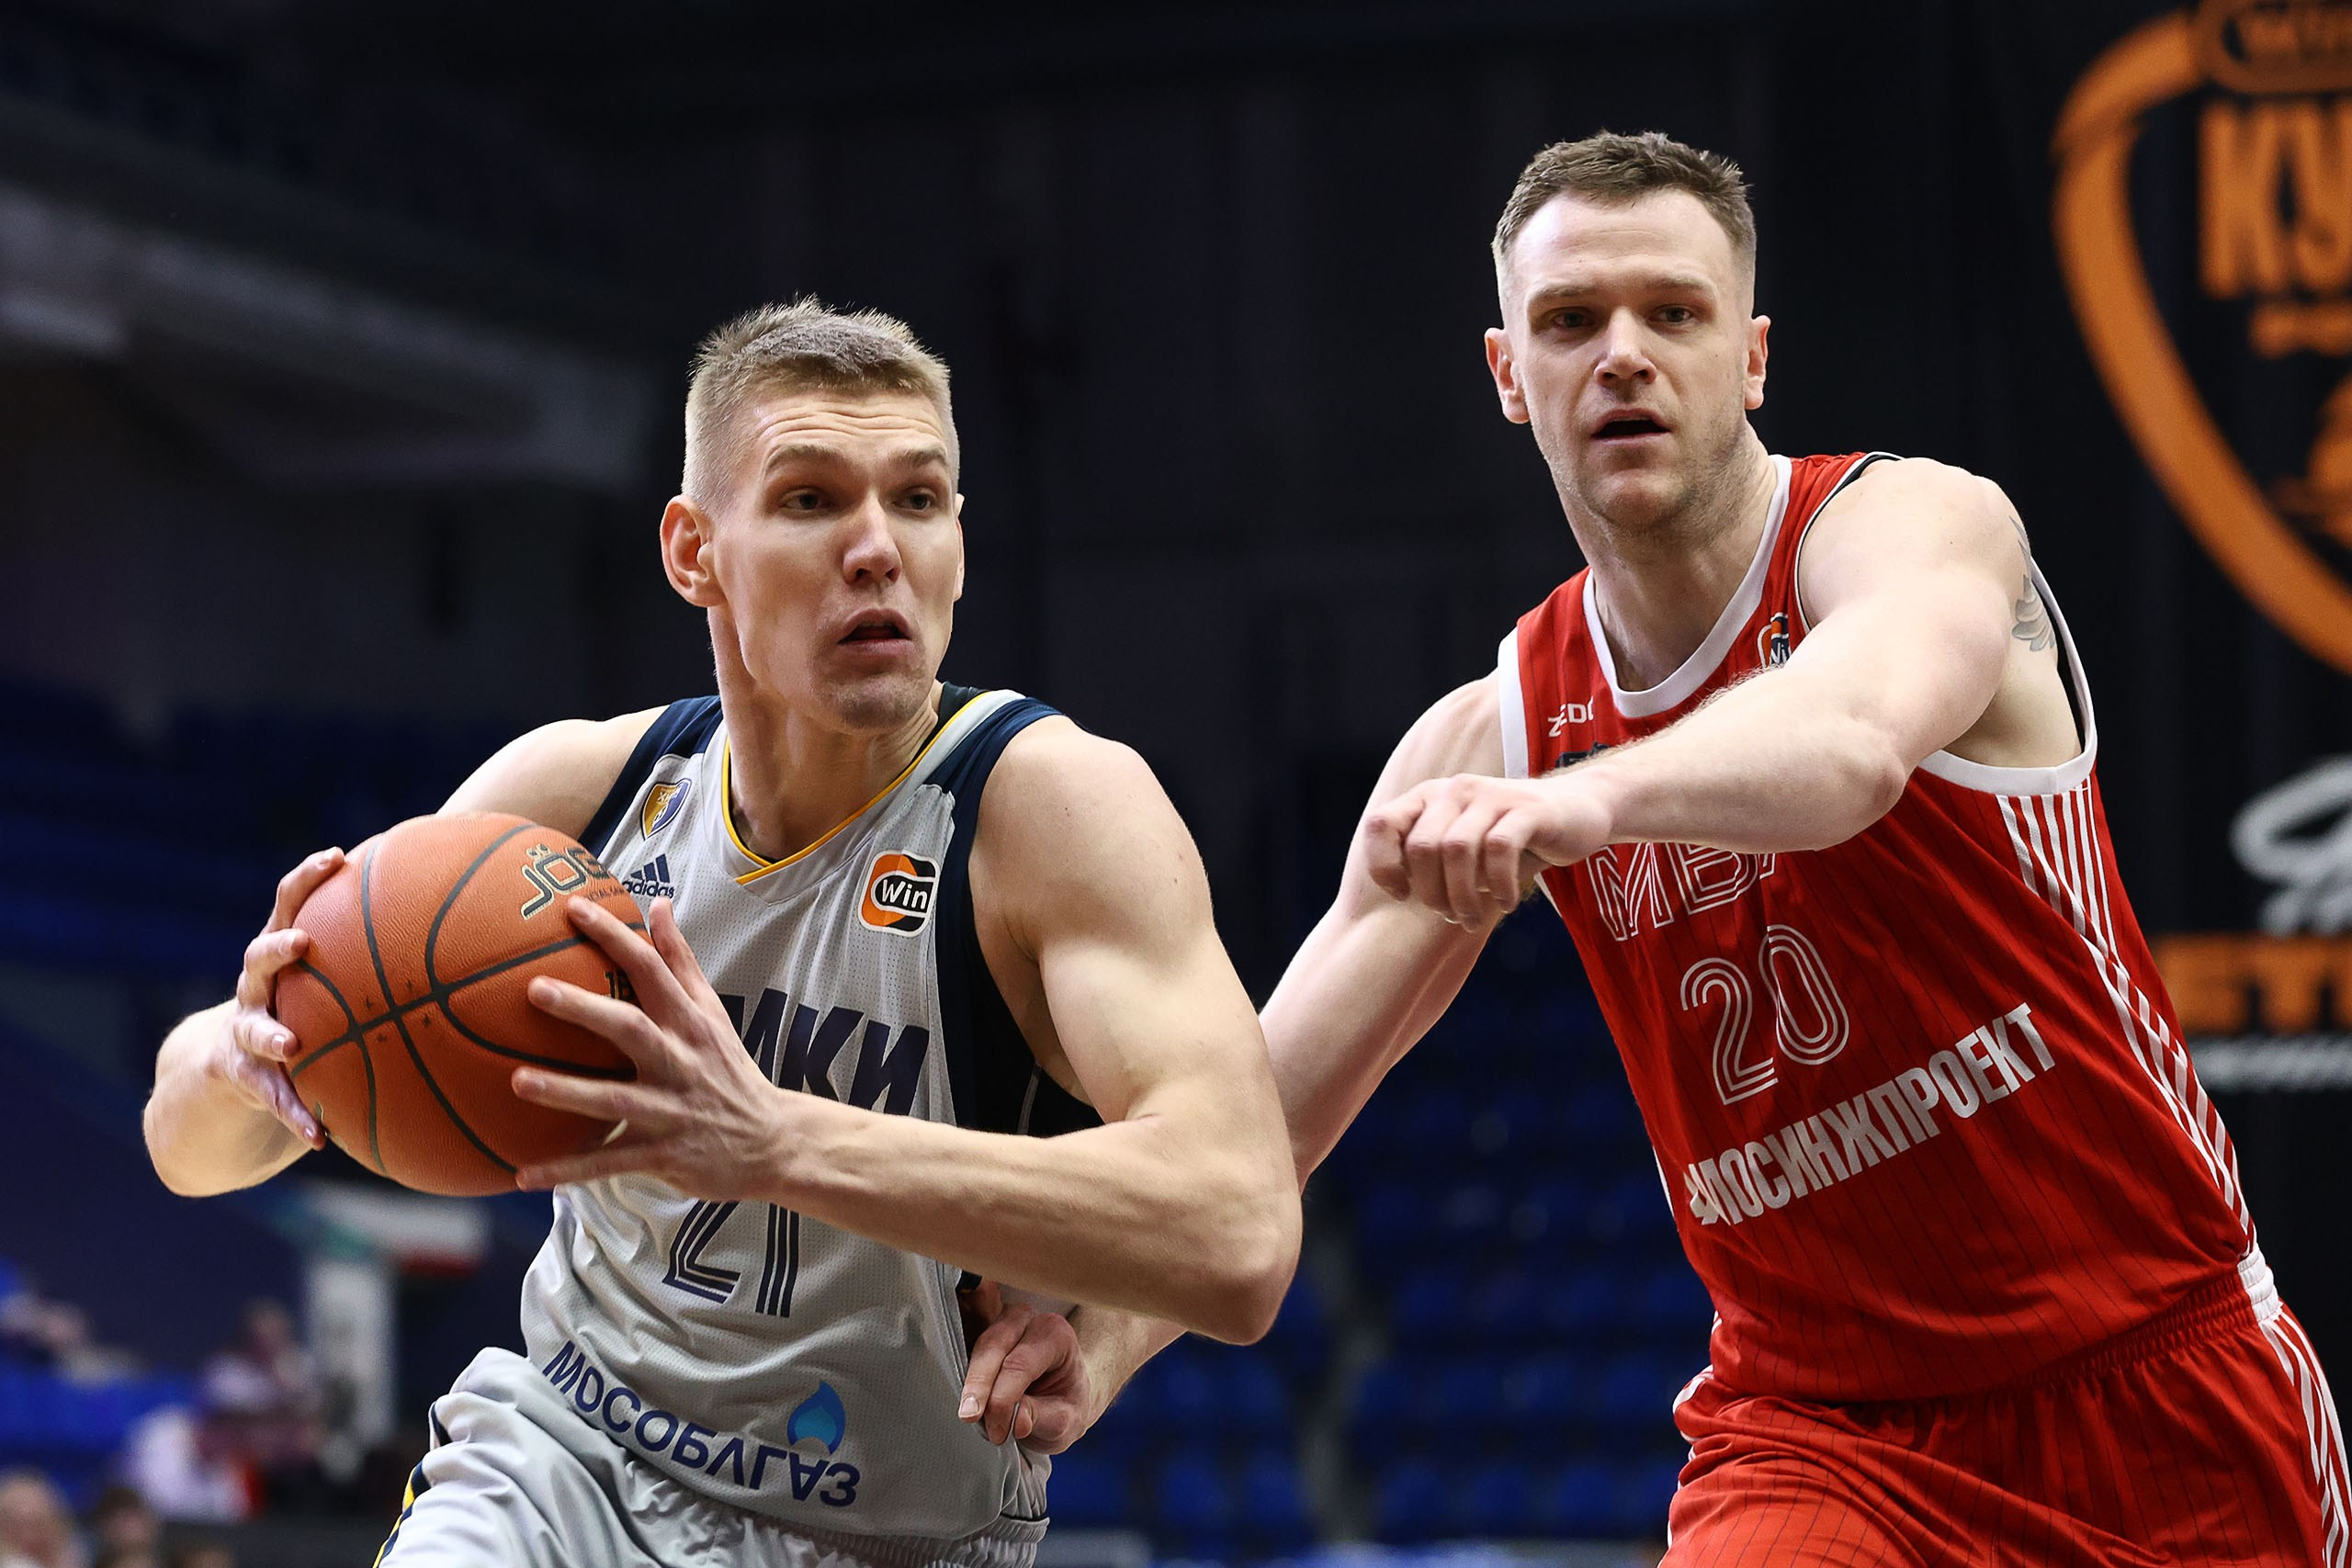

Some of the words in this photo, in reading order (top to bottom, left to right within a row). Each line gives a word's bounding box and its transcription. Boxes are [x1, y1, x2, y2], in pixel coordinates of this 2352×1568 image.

[622, 877, 675, 899] adidas
[881, 879, 928, 909] Win
[1680, 923, 1849, 1106] 20
[542, 1340, 861, 1507] МОСОБЛГАЗ
